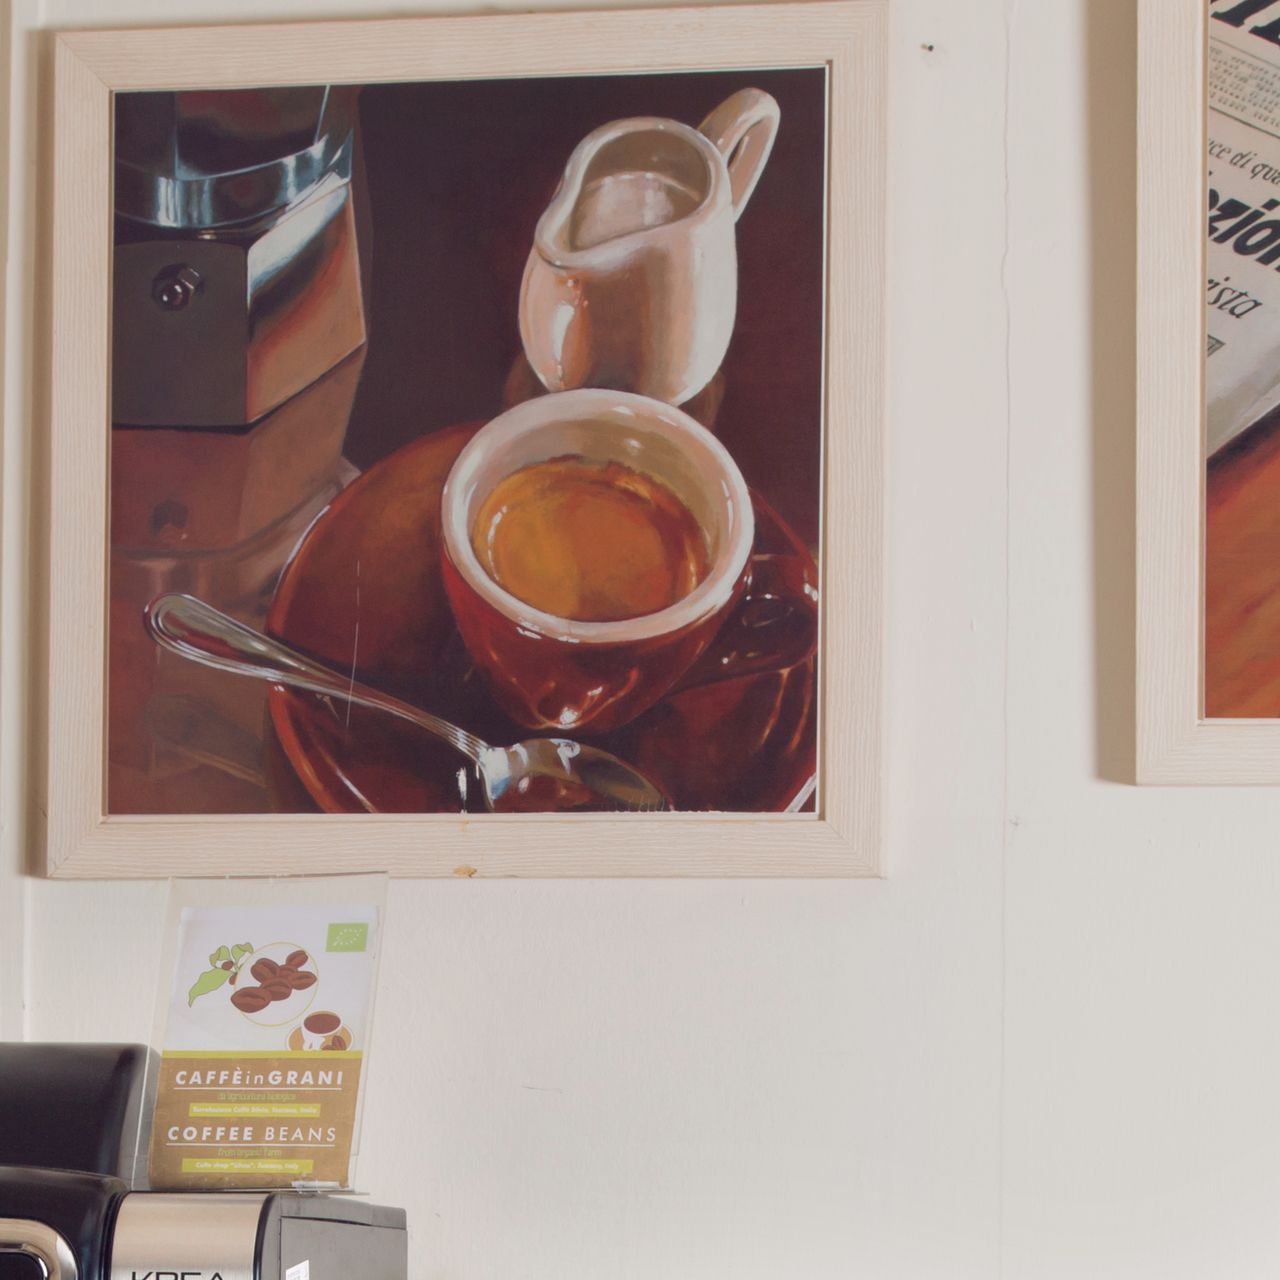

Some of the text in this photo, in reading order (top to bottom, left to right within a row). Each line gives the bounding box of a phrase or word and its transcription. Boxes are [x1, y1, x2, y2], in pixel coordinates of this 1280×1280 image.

[1229, 150, 1258, 169] di
[167, 1126, 337, 1142] COFFEE BEANS
